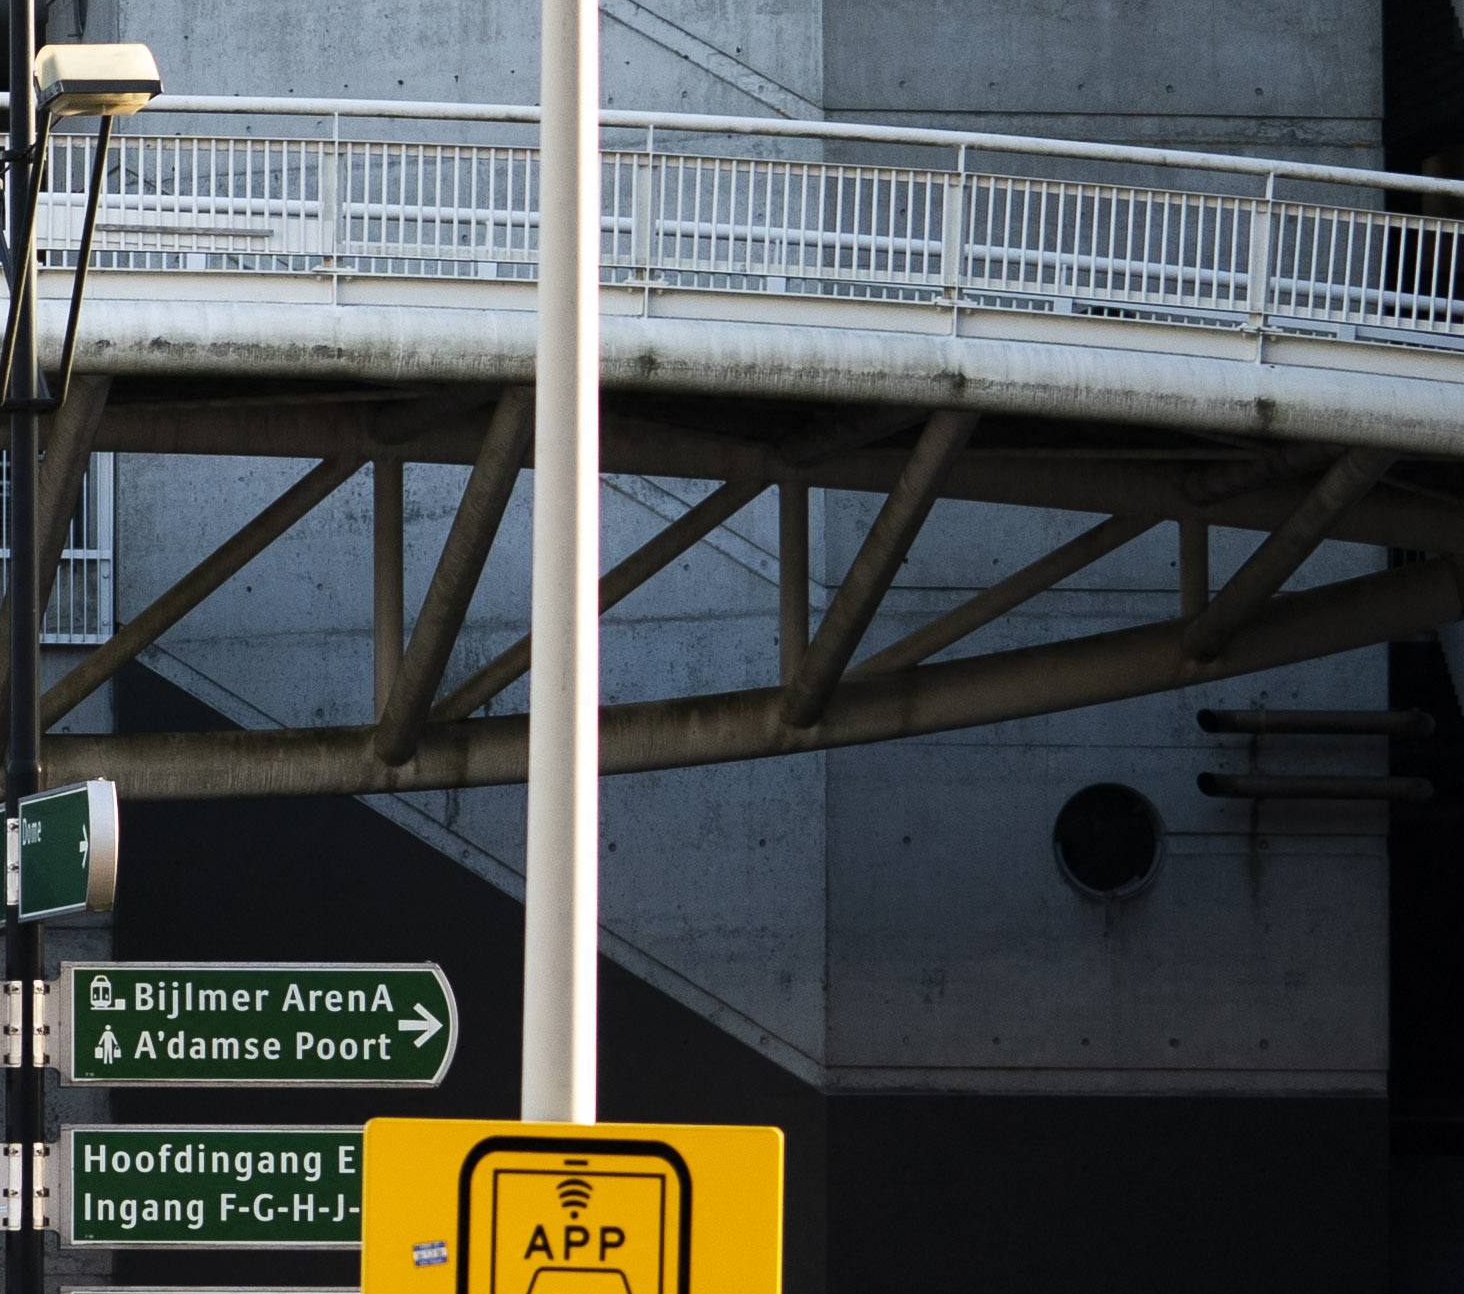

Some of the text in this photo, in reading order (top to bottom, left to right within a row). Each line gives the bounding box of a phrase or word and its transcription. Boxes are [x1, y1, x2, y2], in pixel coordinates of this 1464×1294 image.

[22, 818, 42, 846] Dome
[134, 981, 394, 1019] Bijlmer ArenA
[296, 1031, 392, 1061] Poort
[84, 1143, 356, 1182] Hoofdingang E
[84, 1193, 360, 1229] Ingang F-G-H-J-
[524, 1224, 626, 1262] APP
